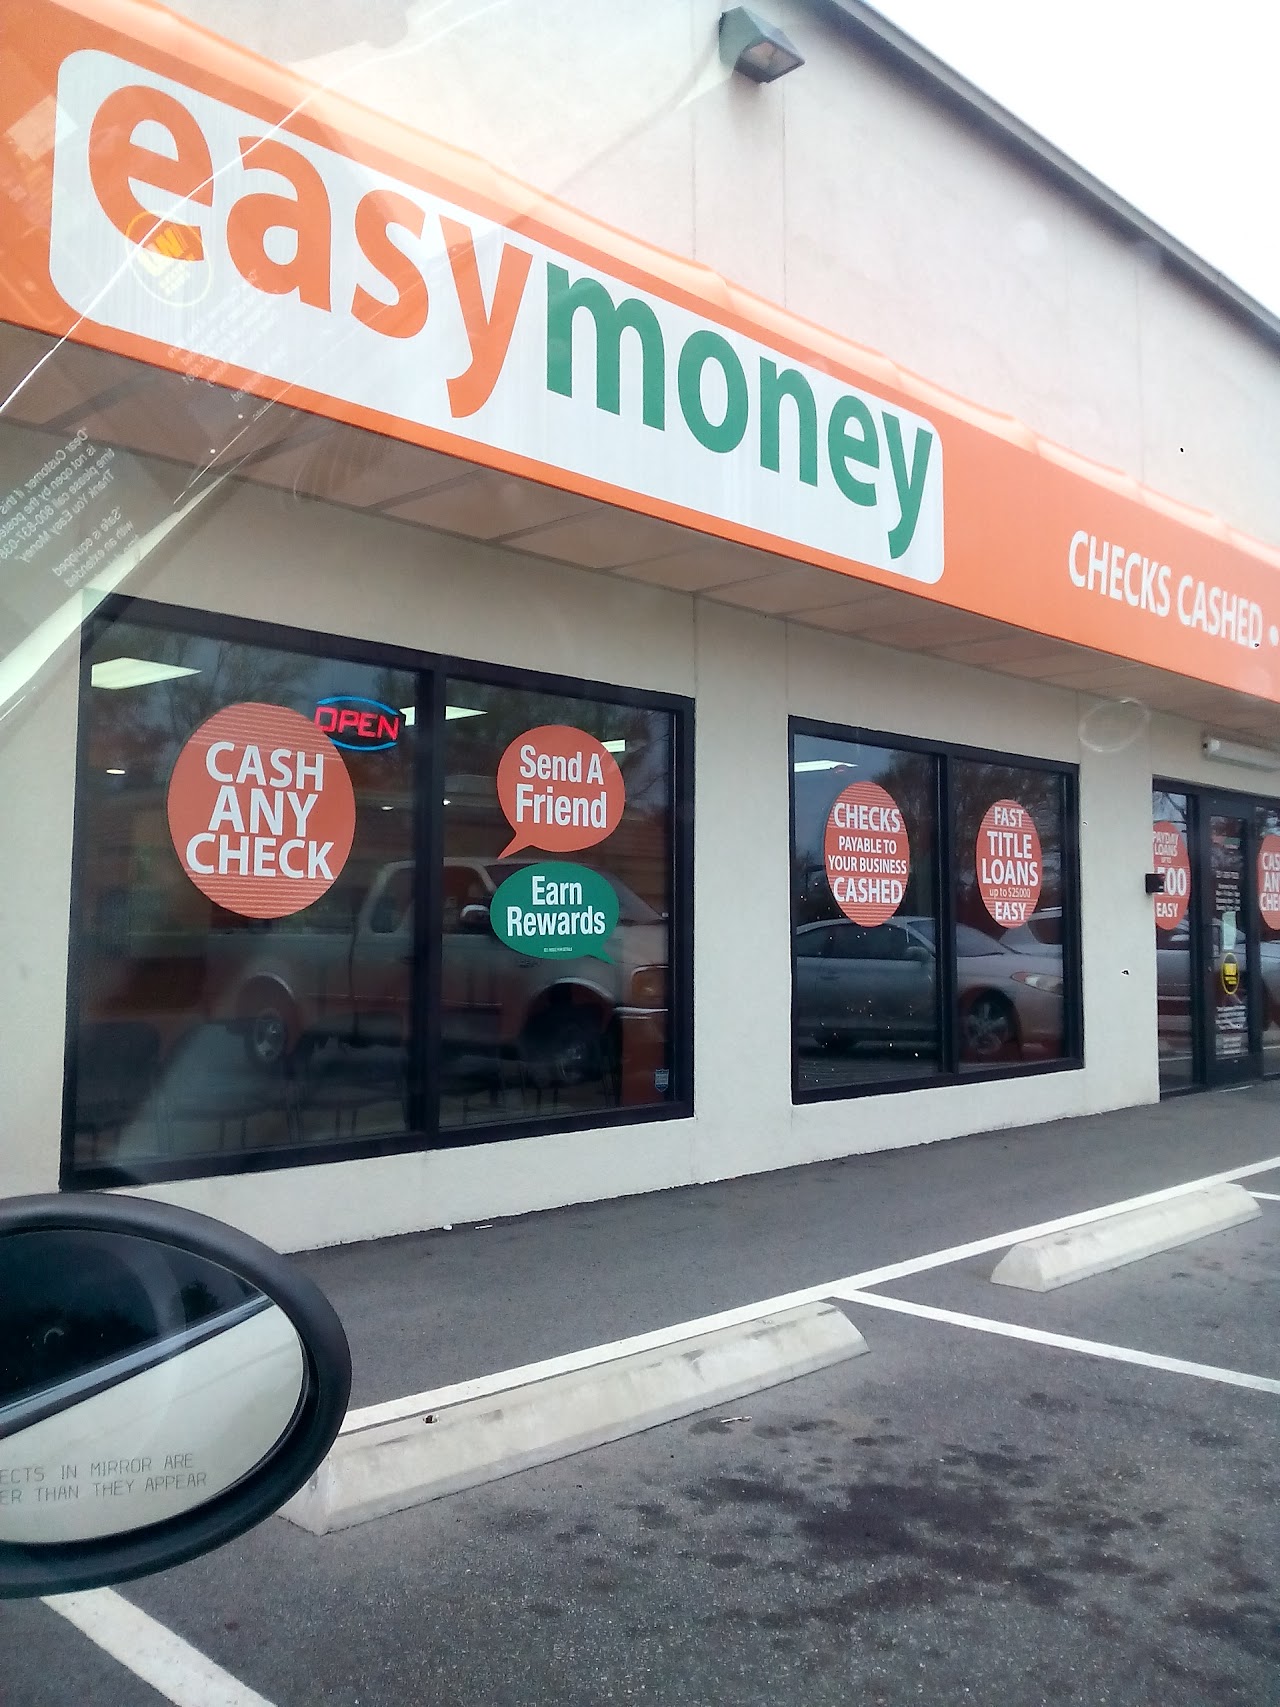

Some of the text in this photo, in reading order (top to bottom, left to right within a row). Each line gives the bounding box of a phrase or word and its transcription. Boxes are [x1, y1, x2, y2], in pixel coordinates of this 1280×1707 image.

[1068, 530, 1263, 649] CHECKS CASHED
[314, 706, 399, 741] OPEN
[205, 741, 324, 791] CASH
[519, 744, 604, 785] Send A
[208, 785, 318, 837] ANY
[516, 783, 607, 829] Friend
[833, 802, 901, 833] CHECKS
[994, 806, 1024, 828] FAST
[186, 832, 334, 880] CHECK
[838, 835, 897, 855] PAYABLE TO
[986, 830, 1033, 859] TITLE
[1155, 843, 1178, 857] LOANS
[828, 854, 907, 875] YOUR BUSINESS
[981, 858, 1039, 887] LOANS
[532, 875, 583, 905] Earn
[833, 877, 903, 904] CASHED
[990, 888, 999, 899] up
[1000, 887, 1008, 897] to
[507, 905, 606, 937] Rewards
[995, 901, 1026, 921] EASY
[1156, 902, 1178, 918] EASY
[62, 1465, 77, 1480] IN
[90, 1457, 152, 1477] MIRROR
[164, 1453, 193, 1470] ARE
[35, 1485, 79, 1502] THAN
[92, 1479, 135, 1497] THEY
[145, 1472, 207, 1493] APPEAR
